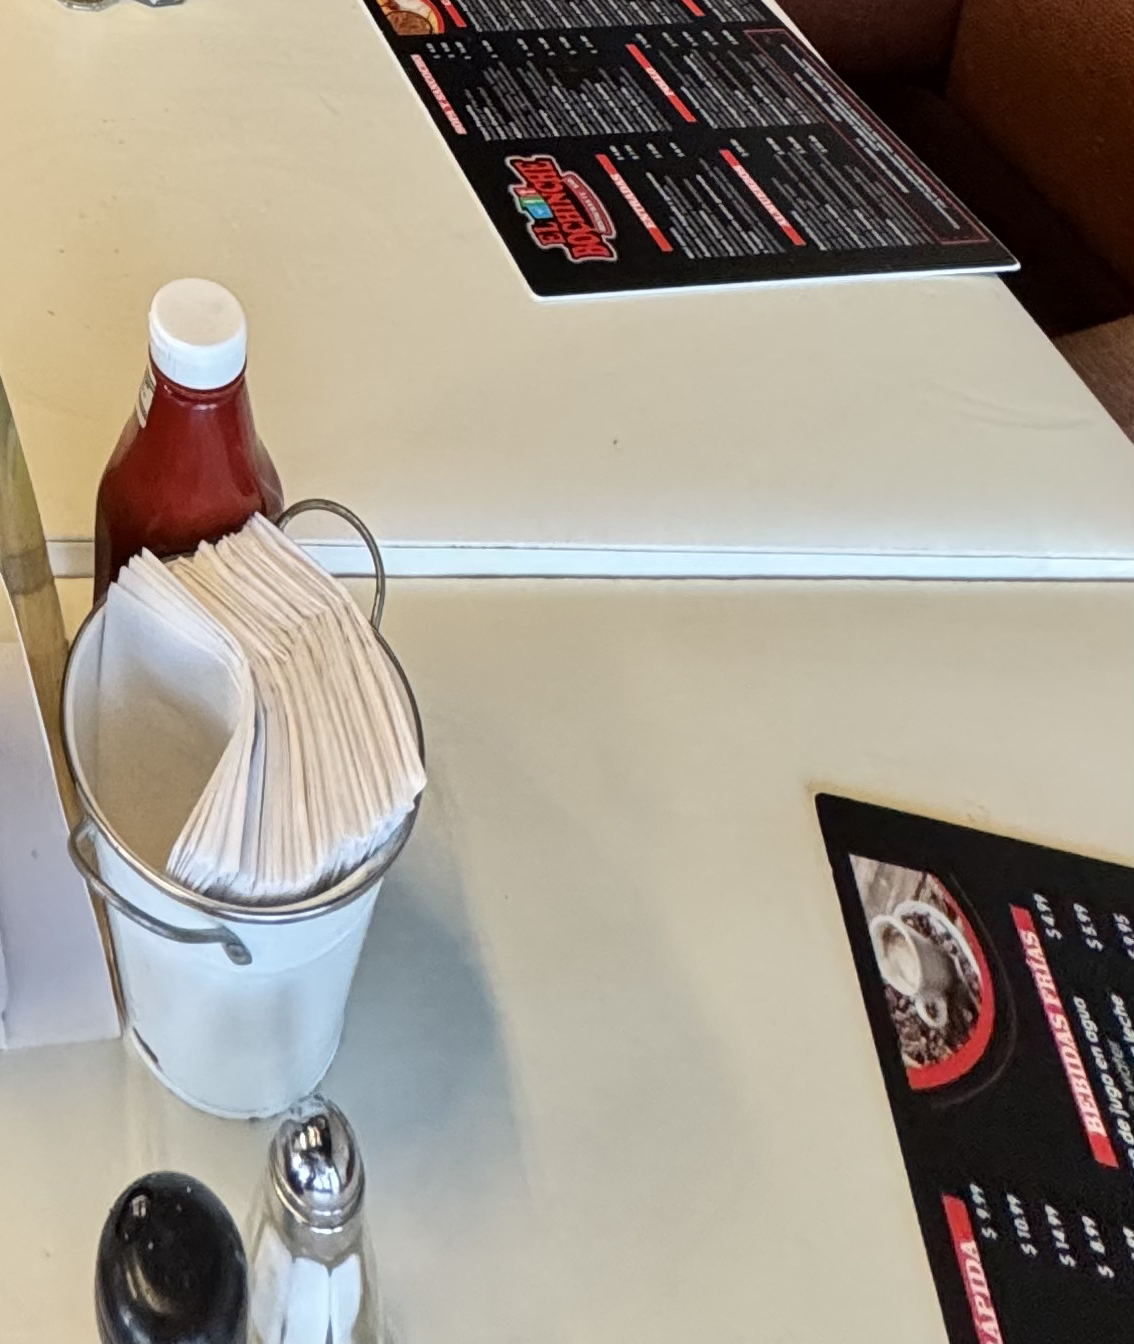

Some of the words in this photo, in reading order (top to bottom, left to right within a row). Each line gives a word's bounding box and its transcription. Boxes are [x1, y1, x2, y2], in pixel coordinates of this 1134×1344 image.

[643, 67, 676, 95] POLLO
[513, 159, 612, 258] BOCHINCHE
[532, 221, 567, 246] EL
[1032, 892, 1057, 927] 4.99
[1073, 902, 1098, 937] 5.99
[1017, 929, 1064, 1007] FRÍAS
[1072, 995, 1099, 1045] agua
[1045, 1012, 1107, 1137] BEBIDAS
[1089, 1045, 1109, 1071] en
[1100, 1073, 1131, 1119] jugo
[969, 1182, 992, 1221] 9.99
[1006, 1193, 1031, 1240] 10.99
[1044, 1204, 1070, 1251] 14.99
[1081, 1215, 1106, 1255] 8.99
